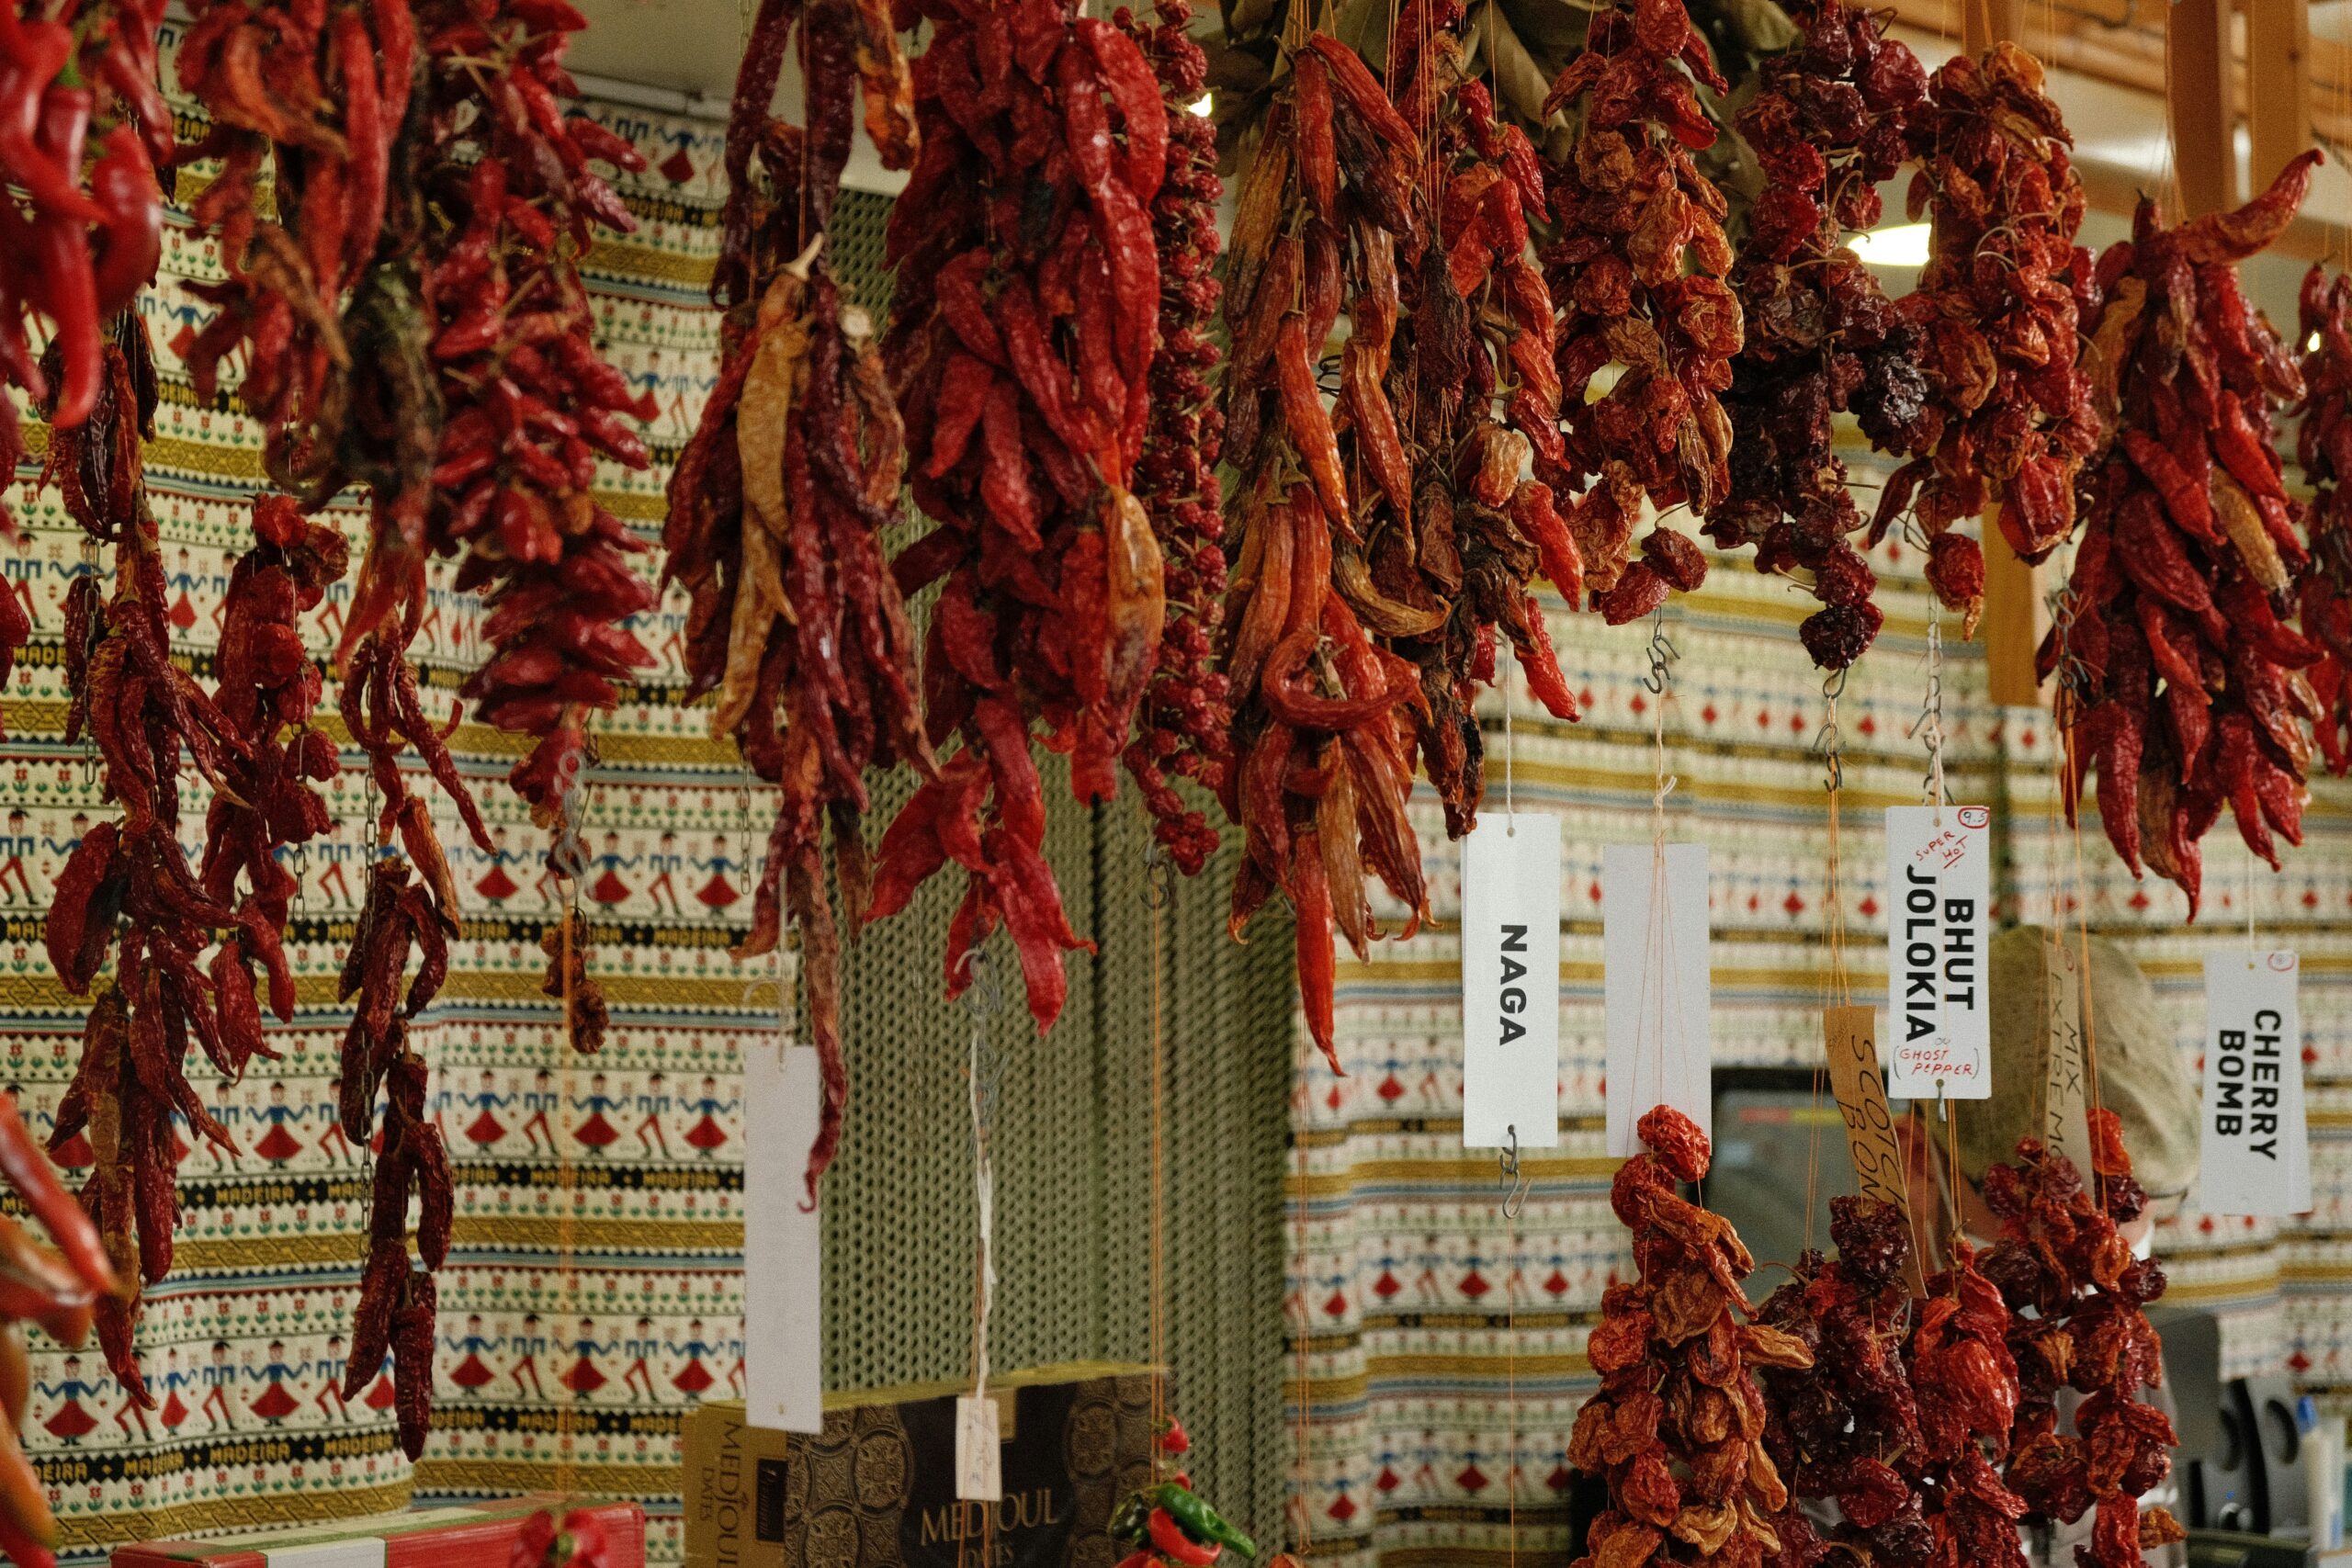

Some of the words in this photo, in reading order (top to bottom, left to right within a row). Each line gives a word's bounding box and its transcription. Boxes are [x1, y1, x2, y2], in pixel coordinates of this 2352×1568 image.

[14, 646, 67, 665] MADE
[1916, 830, 1955, 862] SUPER
[1942, 835, 1968, 863] HOT
[460, 921, 509, 941] DEIRA
[1905, 863, 1937, 1043] JOLOKIA
[1944, 898, 1974, 1010] BHUT
[1498, 924, 1528, 1046] NAGA
[2064, 1021, 2082, 1096] MIX
[2215, 1029, 2246, 1136] BOMB
[2249, 1010, 2282, 1161] CHERRY
[210, 1442, 291, 1464] MADEIRA
[324, 1434, 394, 1456] MADEIRA
[34, 1461, 88, 1482] DEIRA
